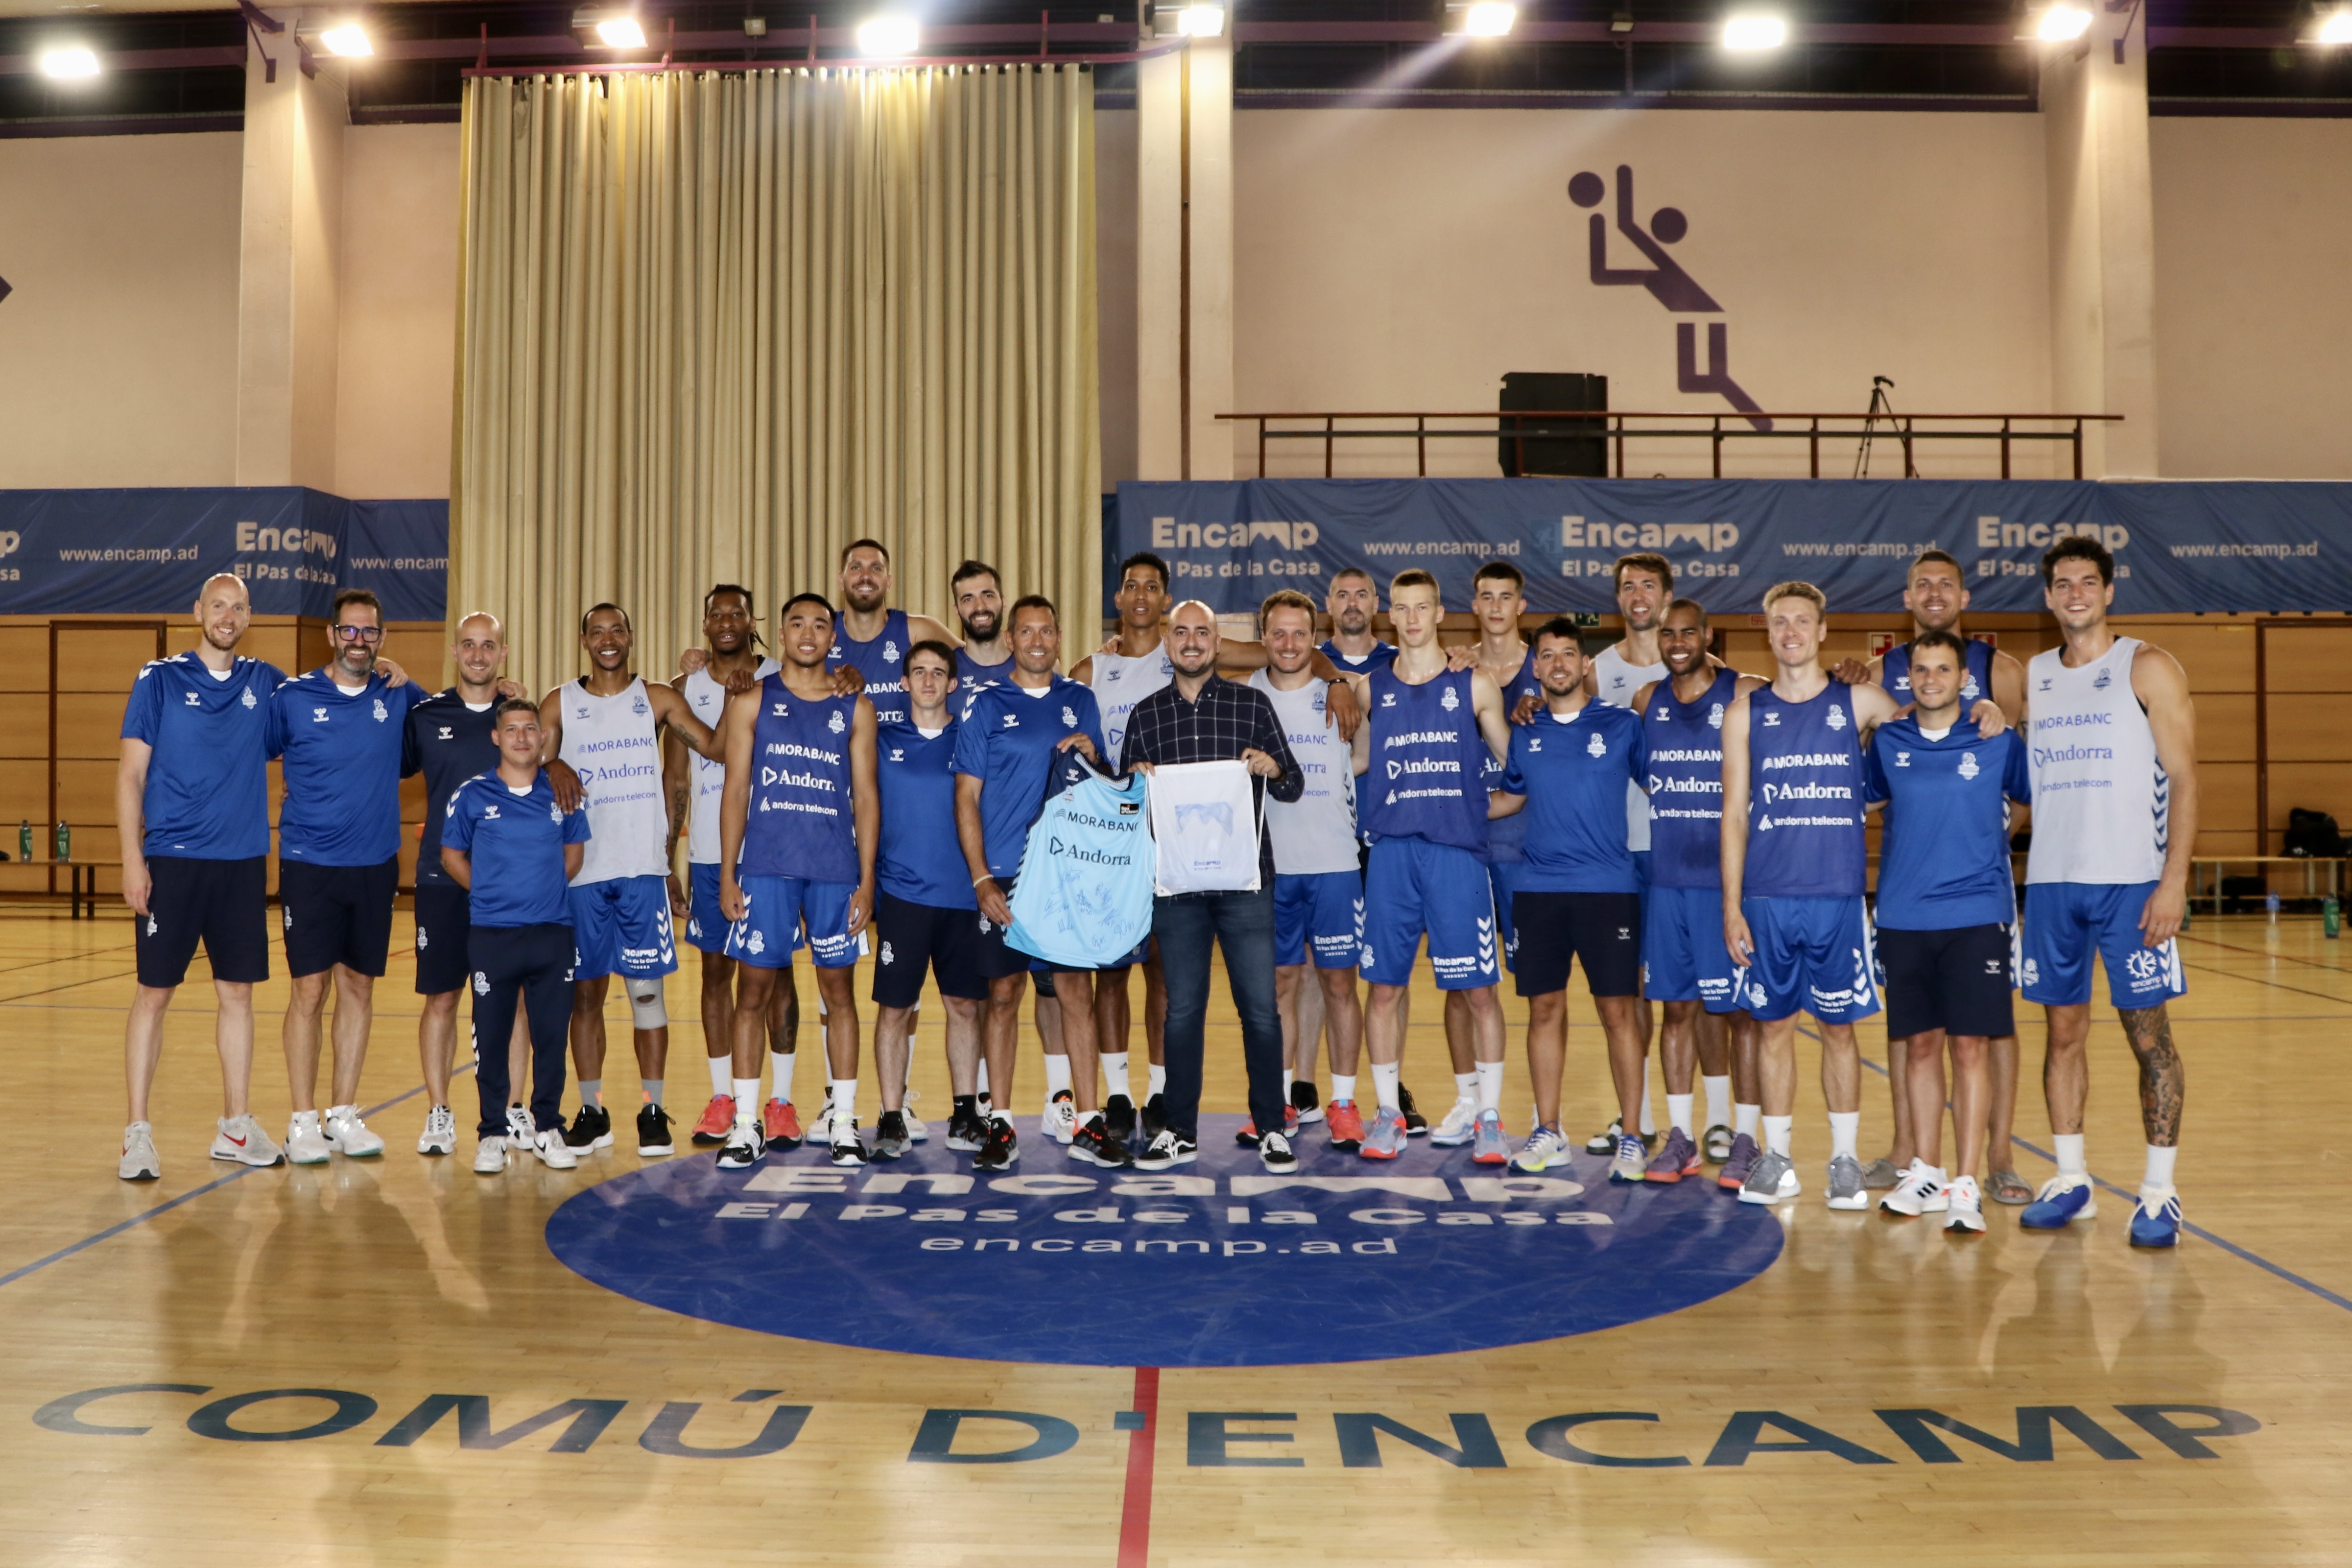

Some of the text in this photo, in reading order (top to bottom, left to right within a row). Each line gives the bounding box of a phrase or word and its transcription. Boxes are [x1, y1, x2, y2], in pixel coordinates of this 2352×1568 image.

[1152, 517, 1319, 550] Encamp
[1562, 516, 1739, 552] Encamp
[59, 545, 198, 564] www.encamp.ad
[1363, 540, 1520, 559] www.encamp.ad
[2171, 541, 2318, 560] www.encamp.ad
[234, 563, 252, 579] El
[256, 563, 289, 580] Pas
[351, 558, 449, 570] www.encam
[1177, 561, 1213, 577] Pas
[1219, 561, 1242, 577] de
[1247, 559, 1264, 576] la
[1269, 558, 1321, 576] Casa
[1562, 560, 1581, 576] El
[1587, 561, 1614, 577] Pa
[1687, 560, 1740, 577] Casa
[1978, 560, 1996, 577] El
[2001, 561, 2036, 576] Pas
[862, 682, 904, 694] ABANC
[877, 711, 904, 723] orra
[2039, 713, 2113, 731] MORABANC
[1288, 734, 1328, 745] ABANC
[1396, 731, 1458, 747] MORABANC
[775, 743, 841, 765] MORABANC
[1658, 749, 1723, 762] MORABAN
[1773, 753, 1850, 769] MORABANC
[2045, 744, 2113, 764] Andorra
[596, 763, 655, 781] Andorra
[1299, 763, 1327, 774] orra
[1403, 757, 1461, 775] Andorra
[779, 769, 836, 792] Andorr
[2042, 779, 2113, 792] andorra telecom
[1427, 787, 1462, 797] telecom
[1779, 781, 1852, 799] Andorra
[594, 794, 625, 806] andorra
[772, 801, 838, 816] andorra telecom
[1659, 808, 1691, 818] andorra
[1773, 815, 1853, 826] andorra telecom
[1066, 844, 1132, 866] Andorra
[1314, 934, 1354, 945] Encamp
[622, 947, 658, 957] ncamp
[1433, 955, 1476, 966] Encamp
[1697, 977, 1729, 988] camp
[1810, 984, 1853, 1000] Encamp
[741, 1165, 1585, 1202] Encamp
[714, 1202, 1615, 1226] El Pas de la Casa
[919, 1236, 1398, 1258] encamp.ad
[32, 1383, 2262, 1468] COMÚ D'ENCAMP
